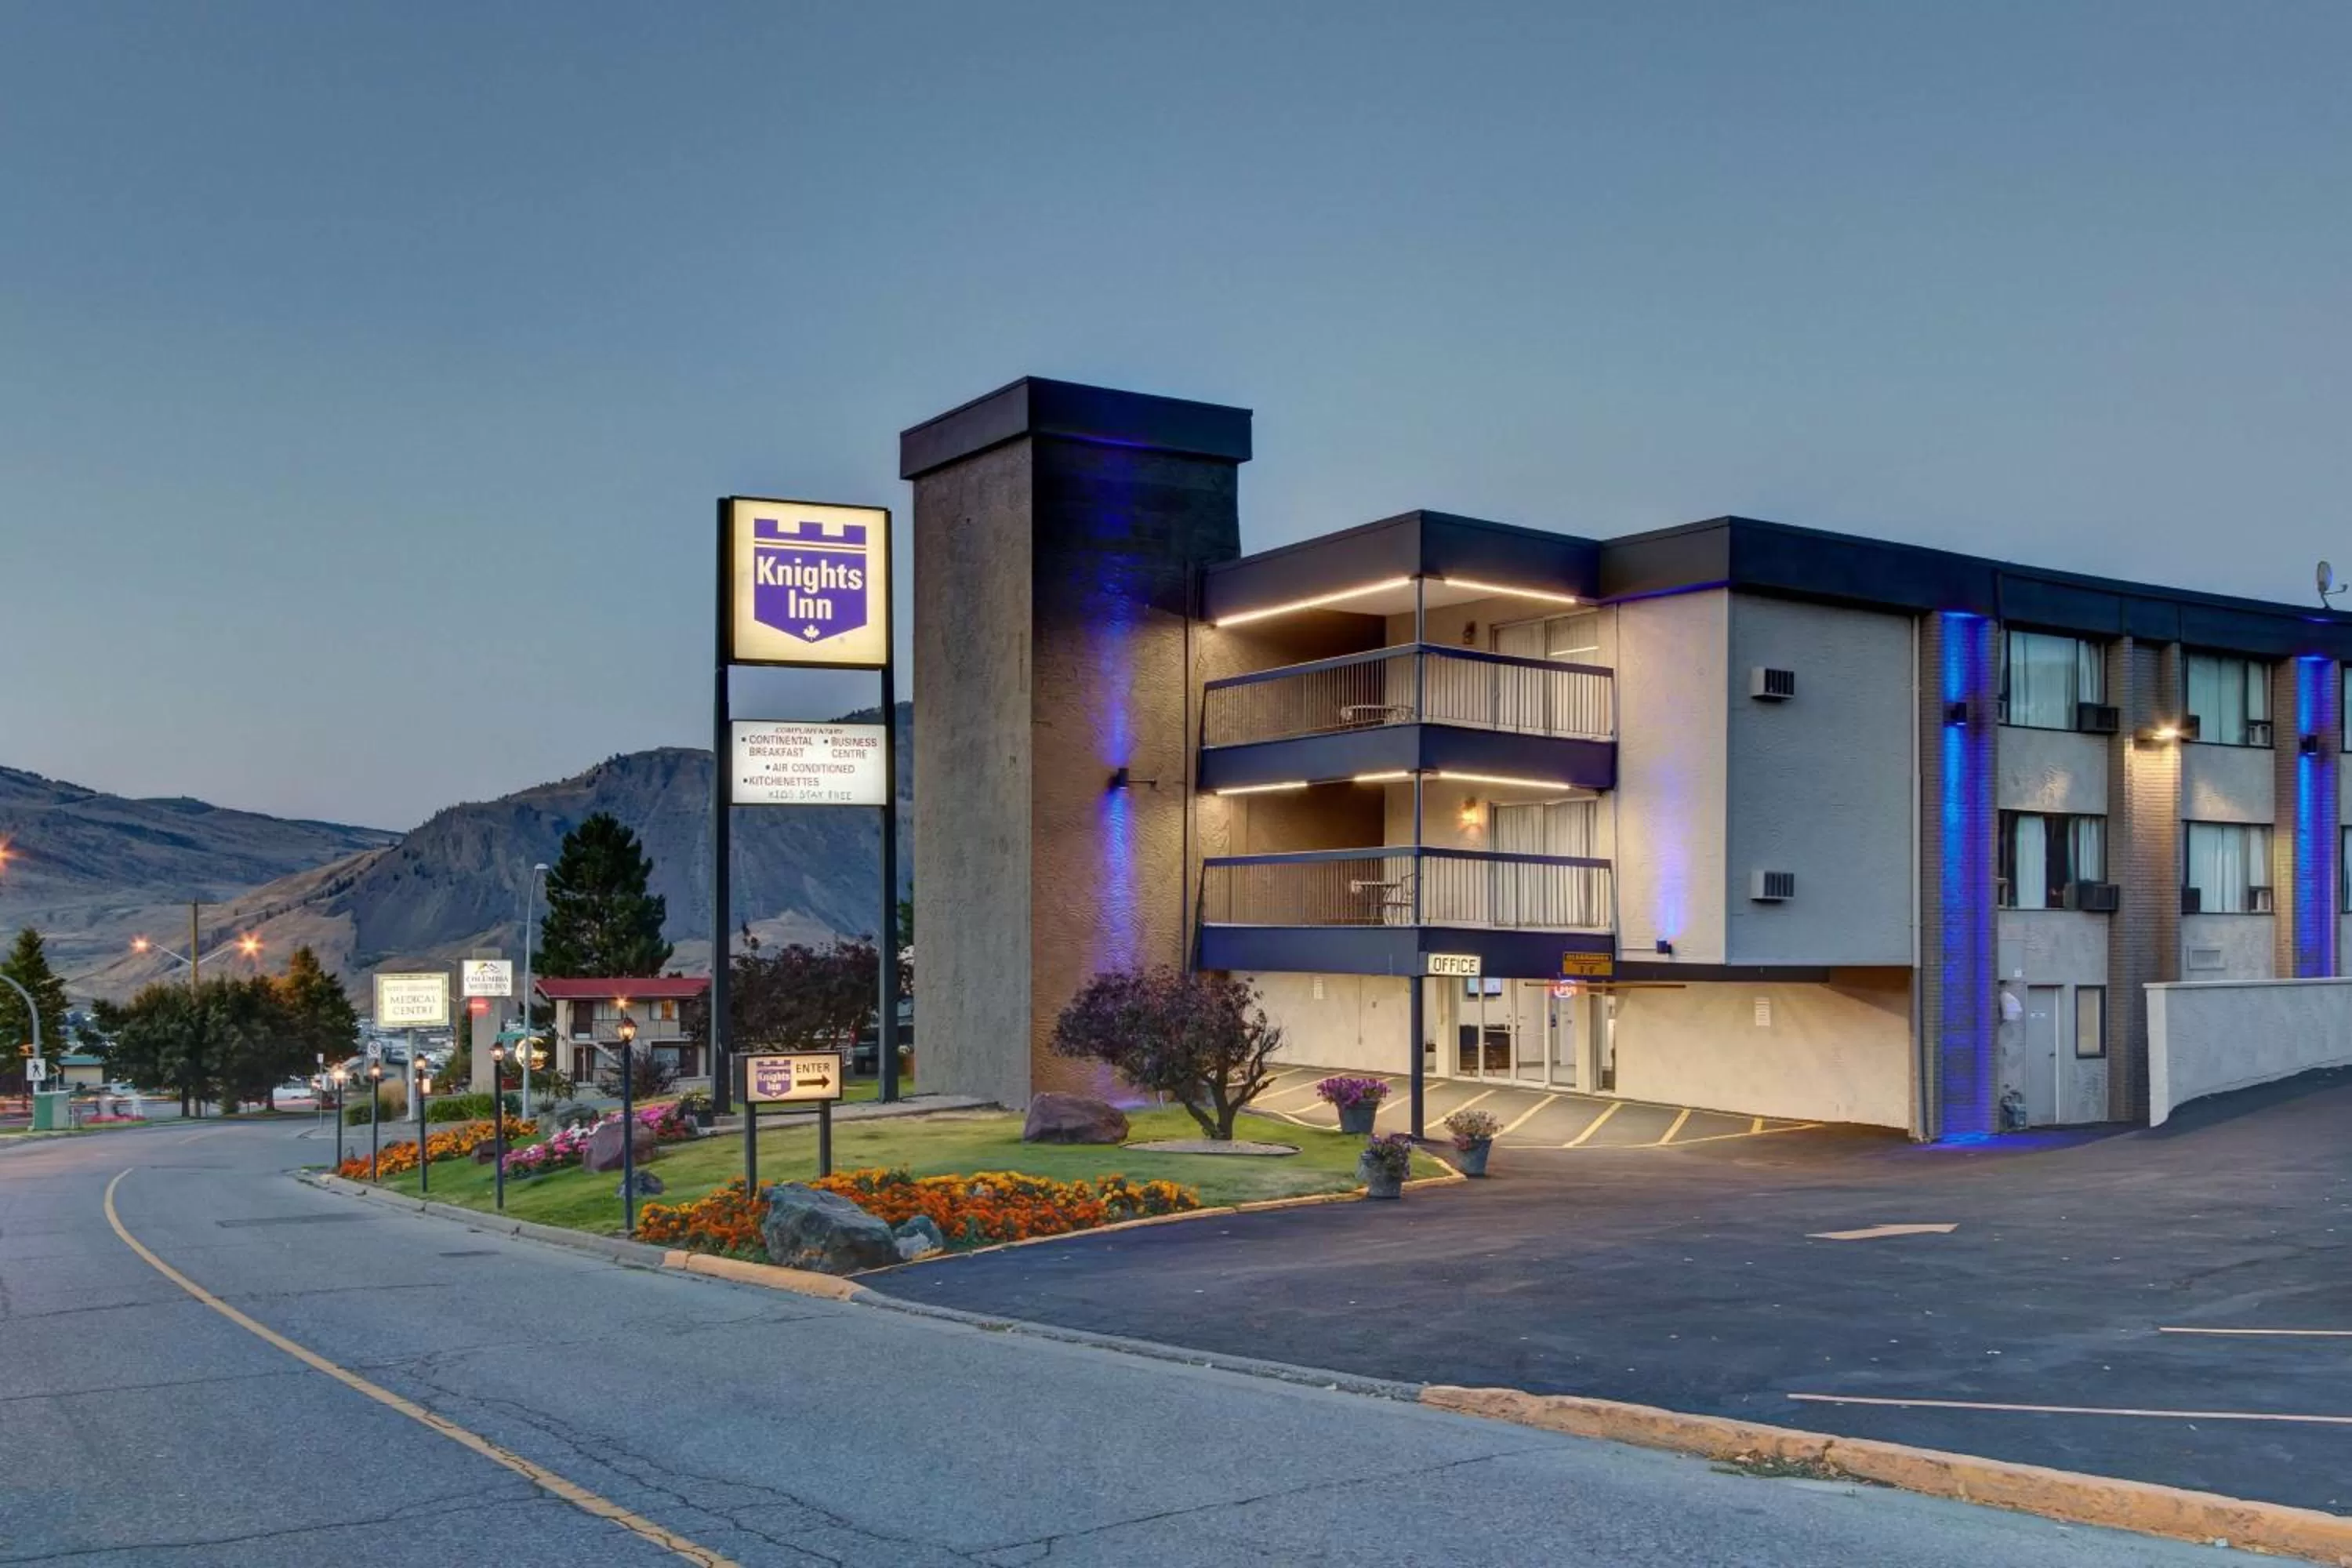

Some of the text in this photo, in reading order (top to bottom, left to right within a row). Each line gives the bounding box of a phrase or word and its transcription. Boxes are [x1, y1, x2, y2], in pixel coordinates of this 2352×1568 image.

[757, 555, 863, 593] Knights
[789, 589, 833, 619] Inn
[749, 735, 813, 746] CONTINENTAL
[831, 737, 877, 747] BUSINESS
[749, 746, 804, 758] BREAKFAST
[832, 749, 867, 759] CENTRE
[772, 763, 855, 774] AIR CONDITIONED
[749, 775, 819, 786] KITCHENETTES
[1433, 957, 1477, 974] OFFICE
[390, 995, 437, 1004] MEDICAL
[393, 1006, 434, 1015] CENTRE
[796, 1062, 831, 1073] ENTER
[757, 1072, 791, 1083] Knights
[766, 1081, 782, 1091] Inn
